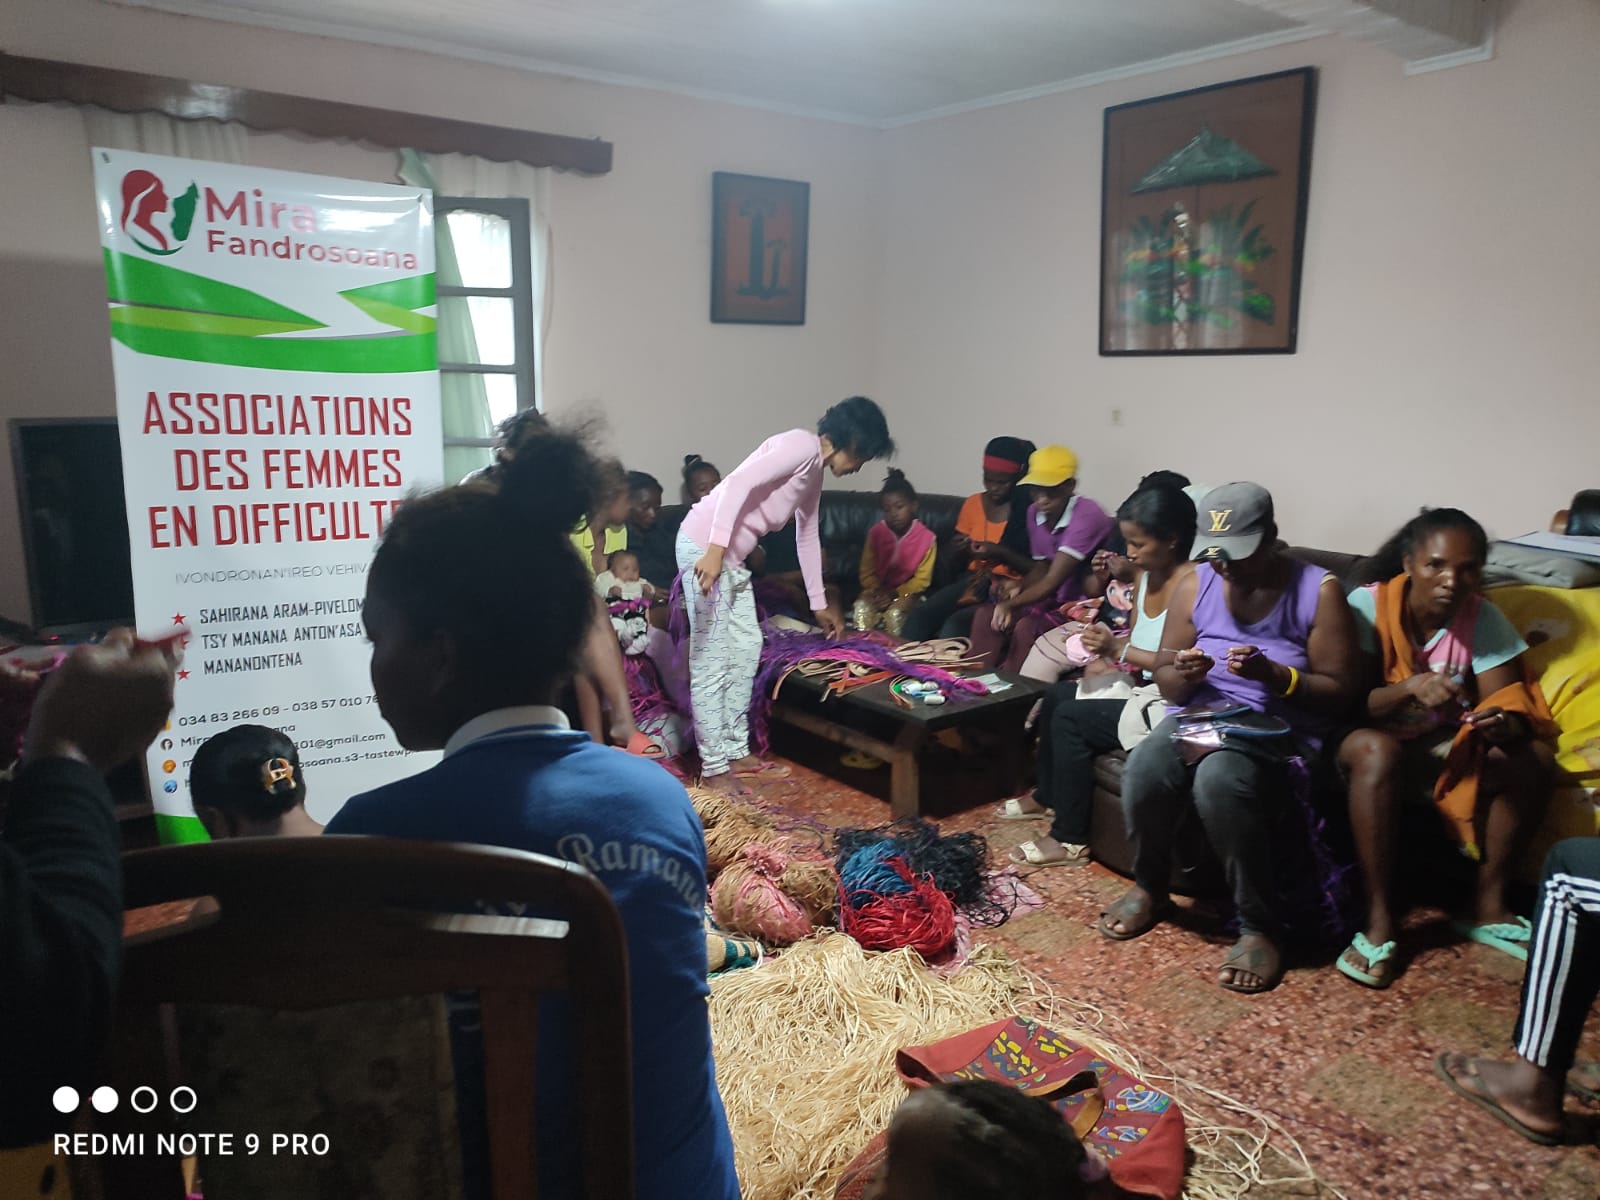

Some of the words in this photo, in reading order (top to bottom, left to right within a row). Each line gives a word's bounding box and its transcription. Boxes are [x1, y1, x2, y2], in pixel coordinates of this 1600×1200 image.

[204, 187, 317, 233] Mira
[206, 229, 419, 271] Fandrosoana
[143, 391, 413, 436] ASSOCIATIONS
[174, 448, 249, 491] DES
[262, 448, 402, 490] FEMMES
[148, 504, 199, 549] EN
[326, 563, 369, 577] VEHIV
[200, 605, 269, 624] SAHIRANA
[201, 634, 227, 650] TSY
[232, 629, 289, 648] MANANA
[294, 622, 363, 642] ANTON'ASA
[203, 651, 303, 676] MANANONTENA
[178, 714, 207, 727] 034
[210, 711, 229, 723] 83
[232, 708, 259, 721] 266
[262, 705, 280, 716] 09
[292, 701, 318, 712] 038
[321, 699, 336, 709] 57
[340, 697, 362, 707] 010
[294, 732, 386, 751] 101@gmail.com
[298, 749, 414, 769] osoana.s3-tastewp
